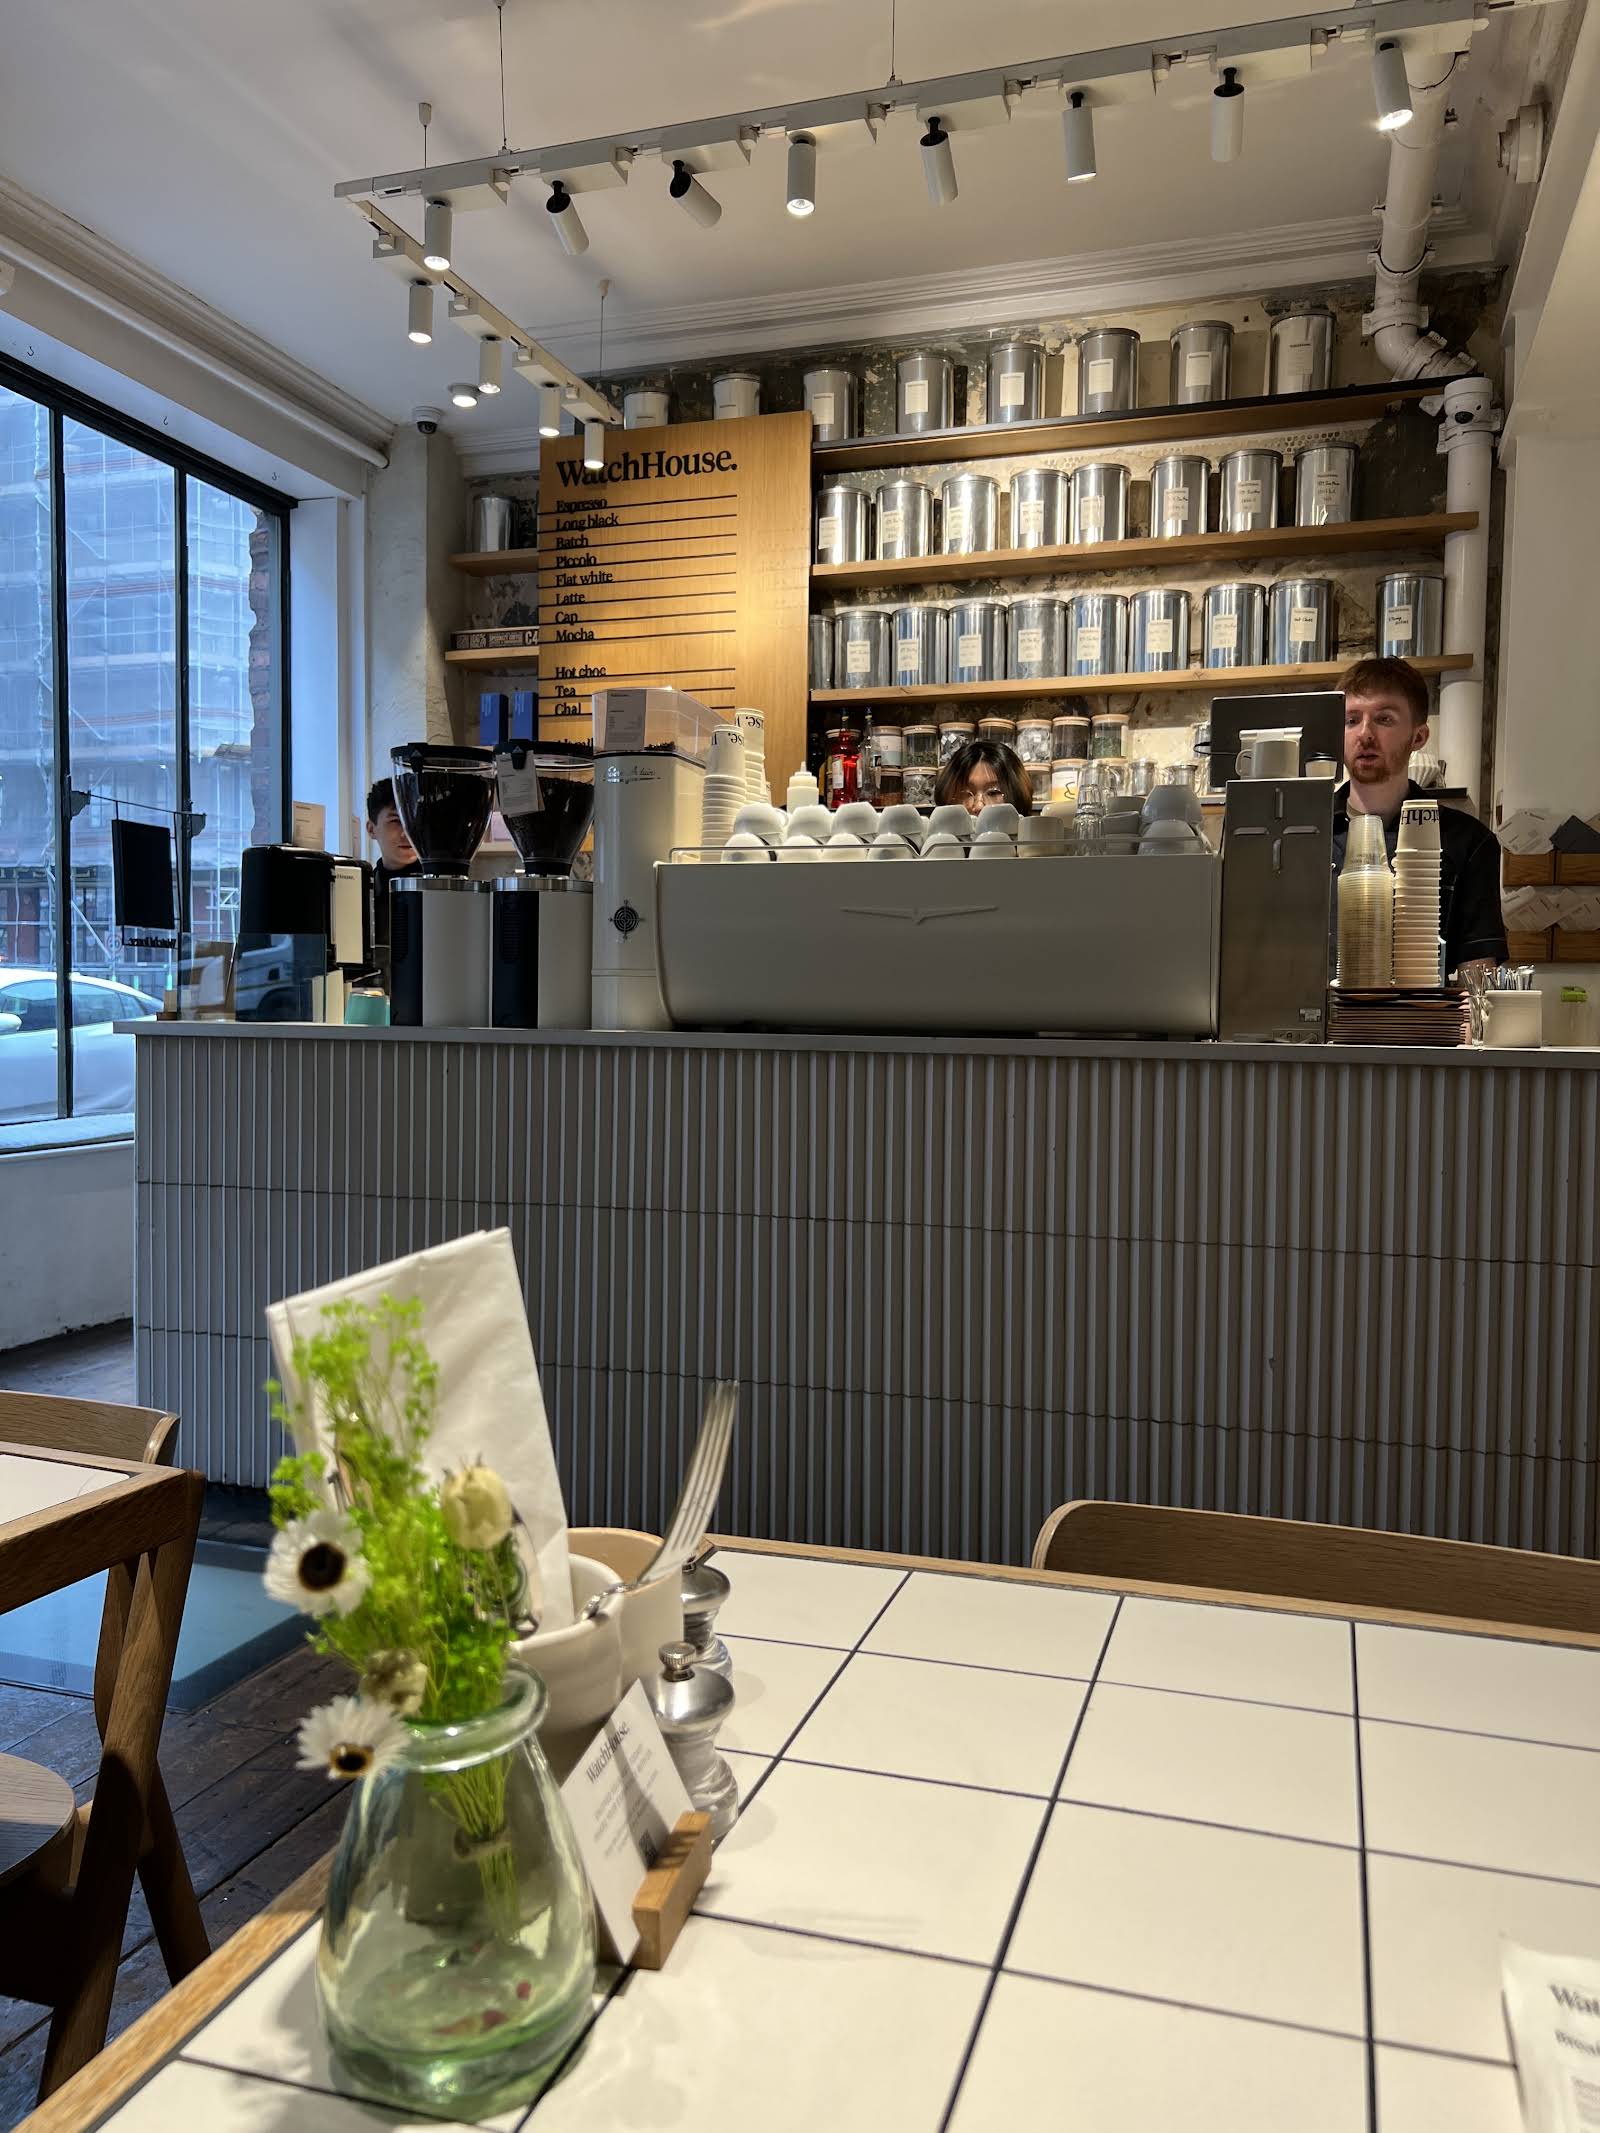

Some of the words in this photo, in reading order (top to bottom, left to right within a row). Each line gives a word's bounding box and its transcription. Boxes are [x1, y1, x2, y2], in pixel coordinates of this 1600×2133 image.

[556, 450, 738, 487] WatchHouse.
[556, 499, 607, 514] Espresso
[556, 519, 586, 531] Long
[587, 512, 619, 528] black
[556, 534, 589, 549] Batch
[556, 553, 597, 568] Piccolo
[556, 573, 578, 587] Flat
[580, 571, 613, 584] white
[556, 593, 585, 605] Latte
[555, 611, 578, 625] Cap
[556, 627, 594, 642] Mocha
[555, 666, 576, 679] Hot
[579, 664, 606, 678] choc
[555, 685, 576, 698] Tea
